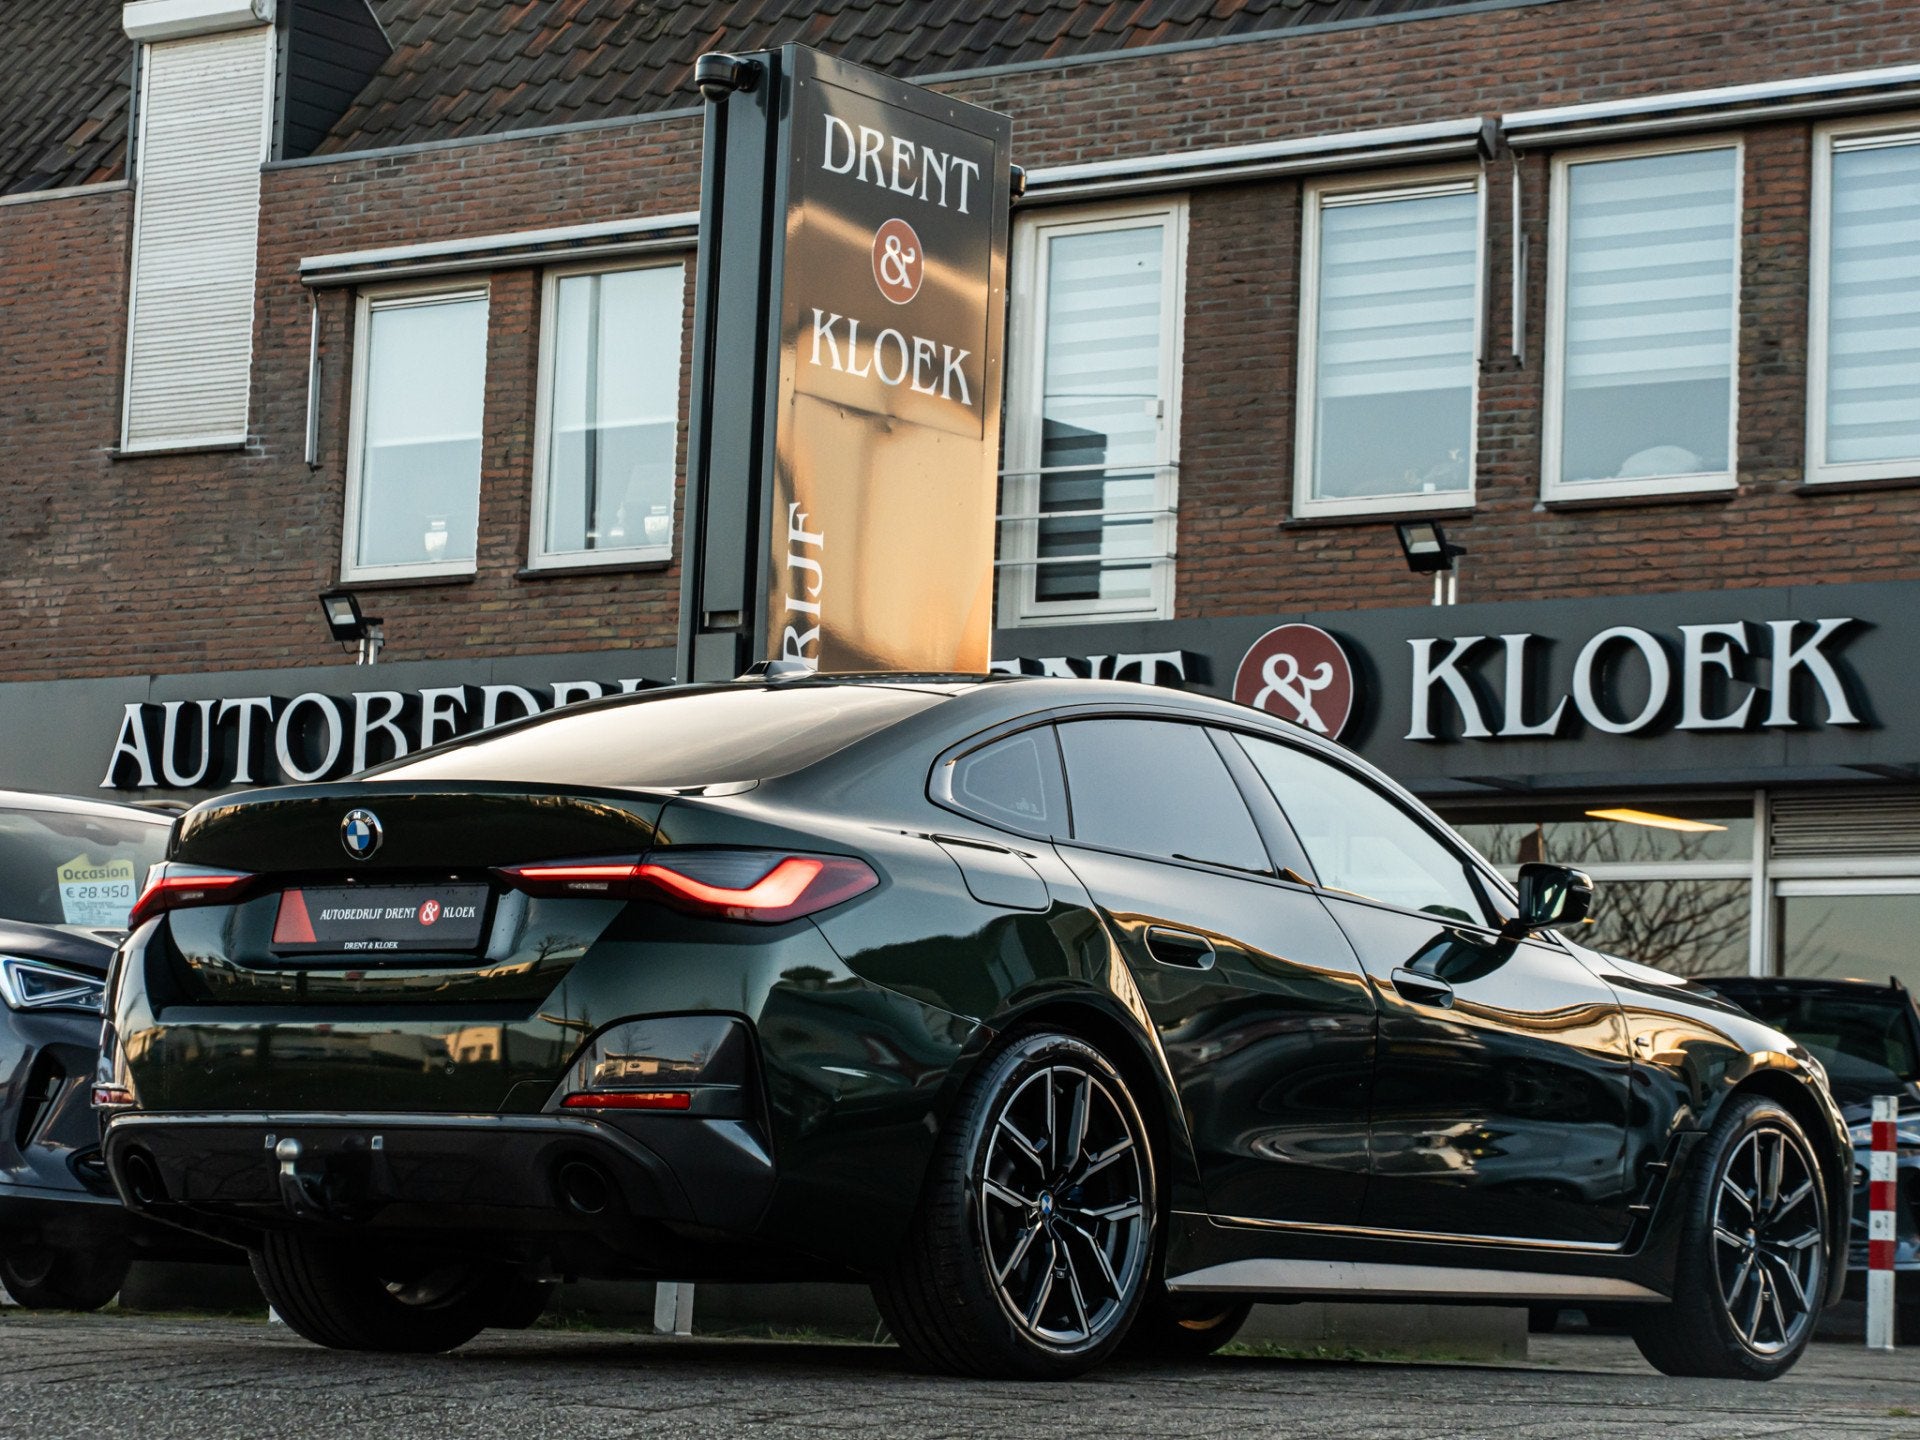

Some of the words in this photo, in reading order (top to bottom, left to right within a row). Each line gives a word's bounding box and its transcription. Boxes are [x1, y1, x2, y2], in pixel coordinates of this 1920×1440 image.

[821, 113, 980, 215] DRENT
[880, 235, 916, 289] &
[809, 308, 972, 405] KLOEK
[1252, 653, 1334, 733] &
[1403, 617, 1861, 740] KLOEK
[100, 684, 677, 788] AUTOBE
[63, 867, 129, 880] Occasion
[79, 885, 129, 898] 28.450
[320, 907, 383, 920] AUTOBEDRIJF
[385, 907, 416, 919] DRENT
[422, 902, 438, 921] &
[442, 906, 475, 918] KLOEK
[344, 942, 368, 950] DRENT
[374, 941, 398, 949] KLOEK
